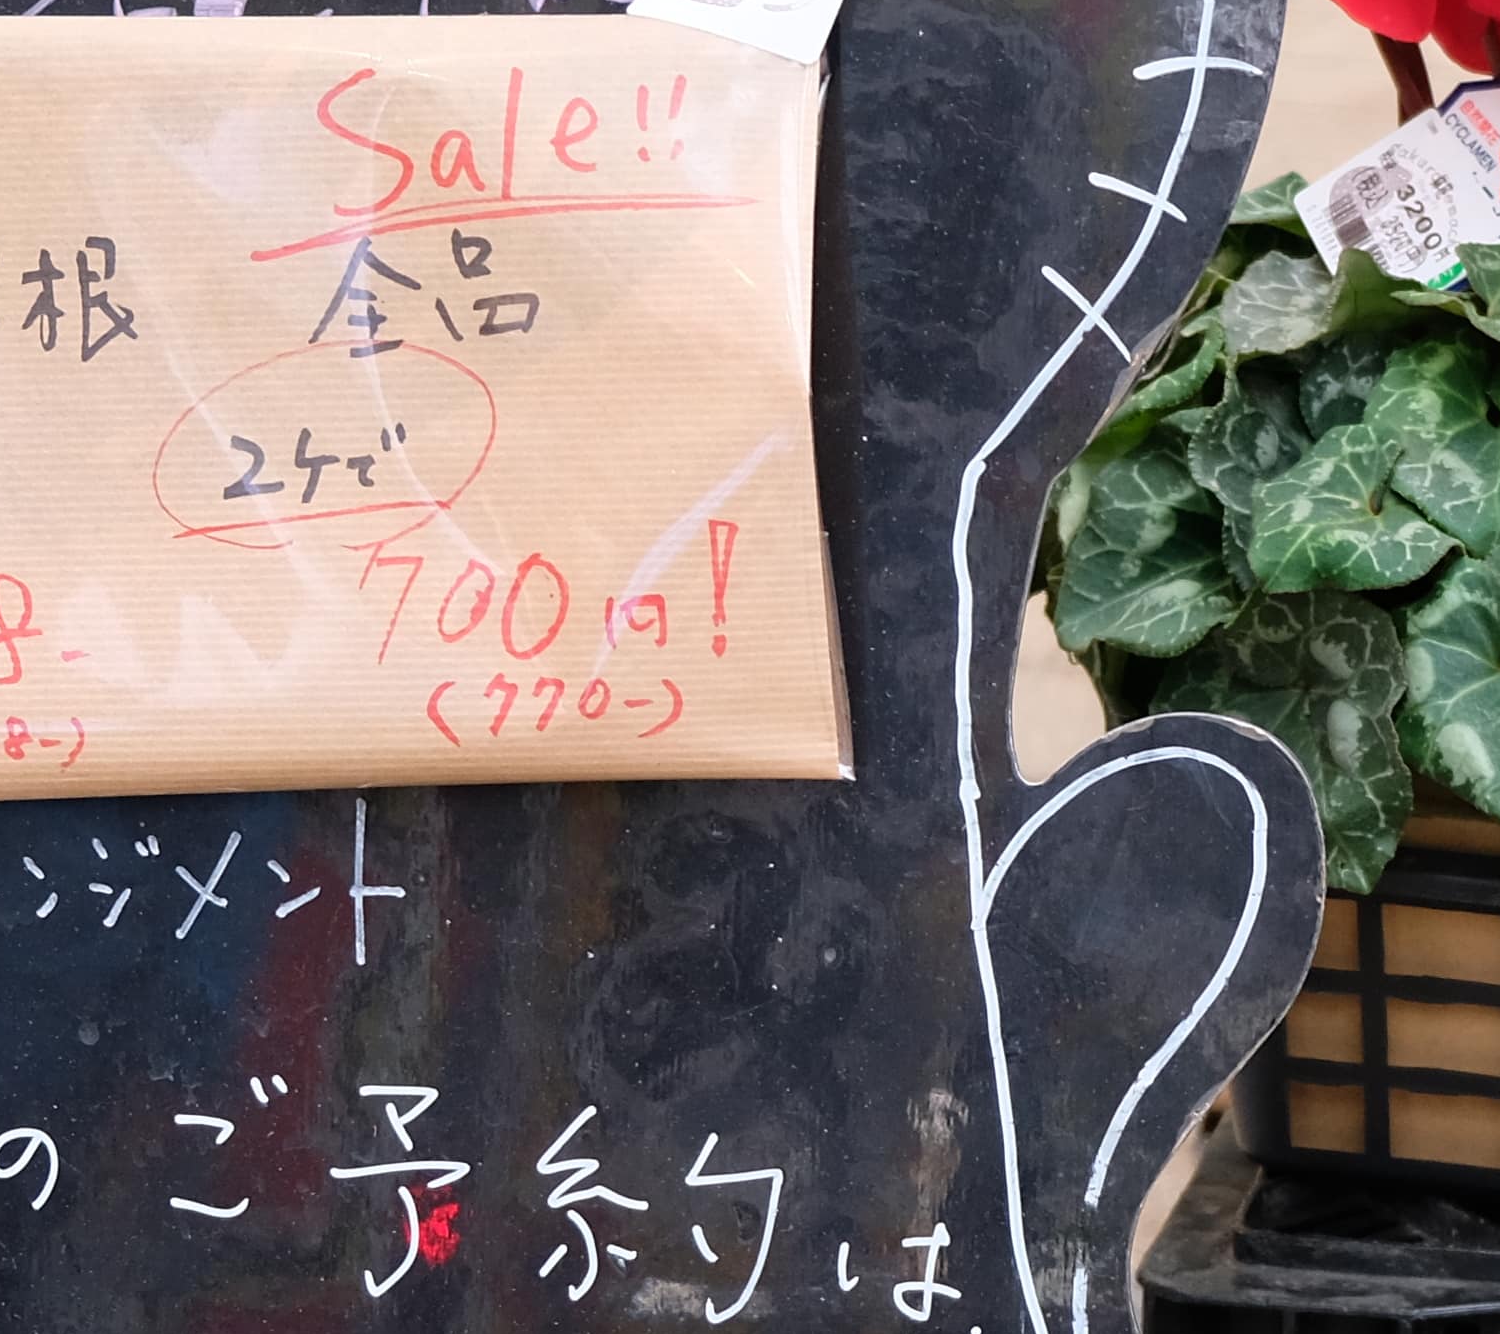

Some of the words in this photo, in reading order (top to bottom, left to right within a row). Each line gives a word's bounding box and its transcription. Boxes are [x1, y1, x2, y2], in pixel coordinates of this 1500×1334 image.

[316, 66, 687, 221] Sale!!
[1444, 113, 1498, 174] CYCLAMEN
[309, 230, 540, 358] 全品
